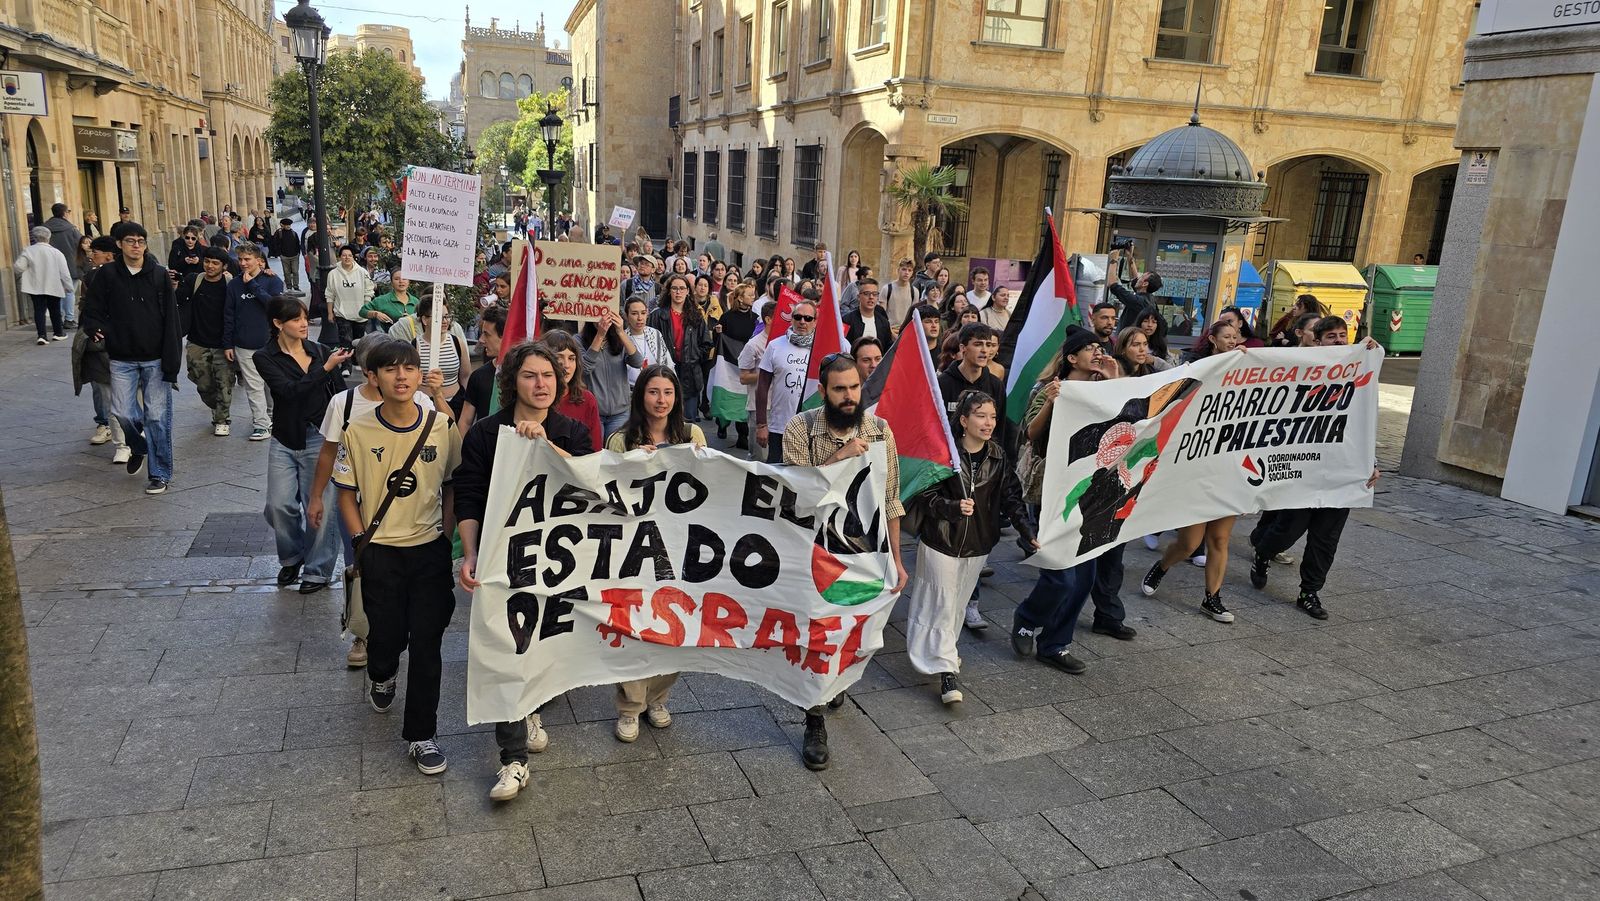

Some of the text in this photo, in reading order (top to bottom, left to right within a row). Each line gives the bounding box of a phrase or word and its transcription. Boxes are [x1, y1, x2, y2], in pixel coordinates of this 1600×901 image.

[78, 128, 112, 138] Zapatos
[82, 145, 111, 155] Bolsos
[430, 173, 442, 185] NO
[443, 175, 477, 192] TERMINA
[409, 188, 458, 204] ALTO EL FUEGO
[418, 220, 428, 229] DEL
[429, 221, 456, 233] APARTHEID
[442, 238, 460, 249] GAZA
[407, 247, 440, 259] LA HAYA
[409, 263, 470, 278] VIVA PALESTINA LIBRE
[559, 258, 582, 269] una
[587, 260, 616, 273] guerra
[342, 280, 356, 288] blur
[560, 273, 618, 291] GENOCIDIO
[554, 291, 568, 299] un
[578, 290, 613, 303] pueblo
[787, 353, 809, 366] Gred
[785, 372, 803, 390] GA
[1221, 361, 1362, 387] HUELGA 15 OCT
[1195, 381, 1356, 427] PARARLO TODO
[1174, 414, 1348, 464] POR PALESTINA
[1267, 452, 1321, 464] COORDINADORA
[1268, 462, 1292, 473] JUVENIL
[1268, 470, 1302, 482] SOCIALISTA
[503, 470, 816, 531] ABAJO EL
[506, 520, 781, 589] ESTADO
[505, 585, 589, 655] DE
[595, 585, 872, 677] ISRAEL
